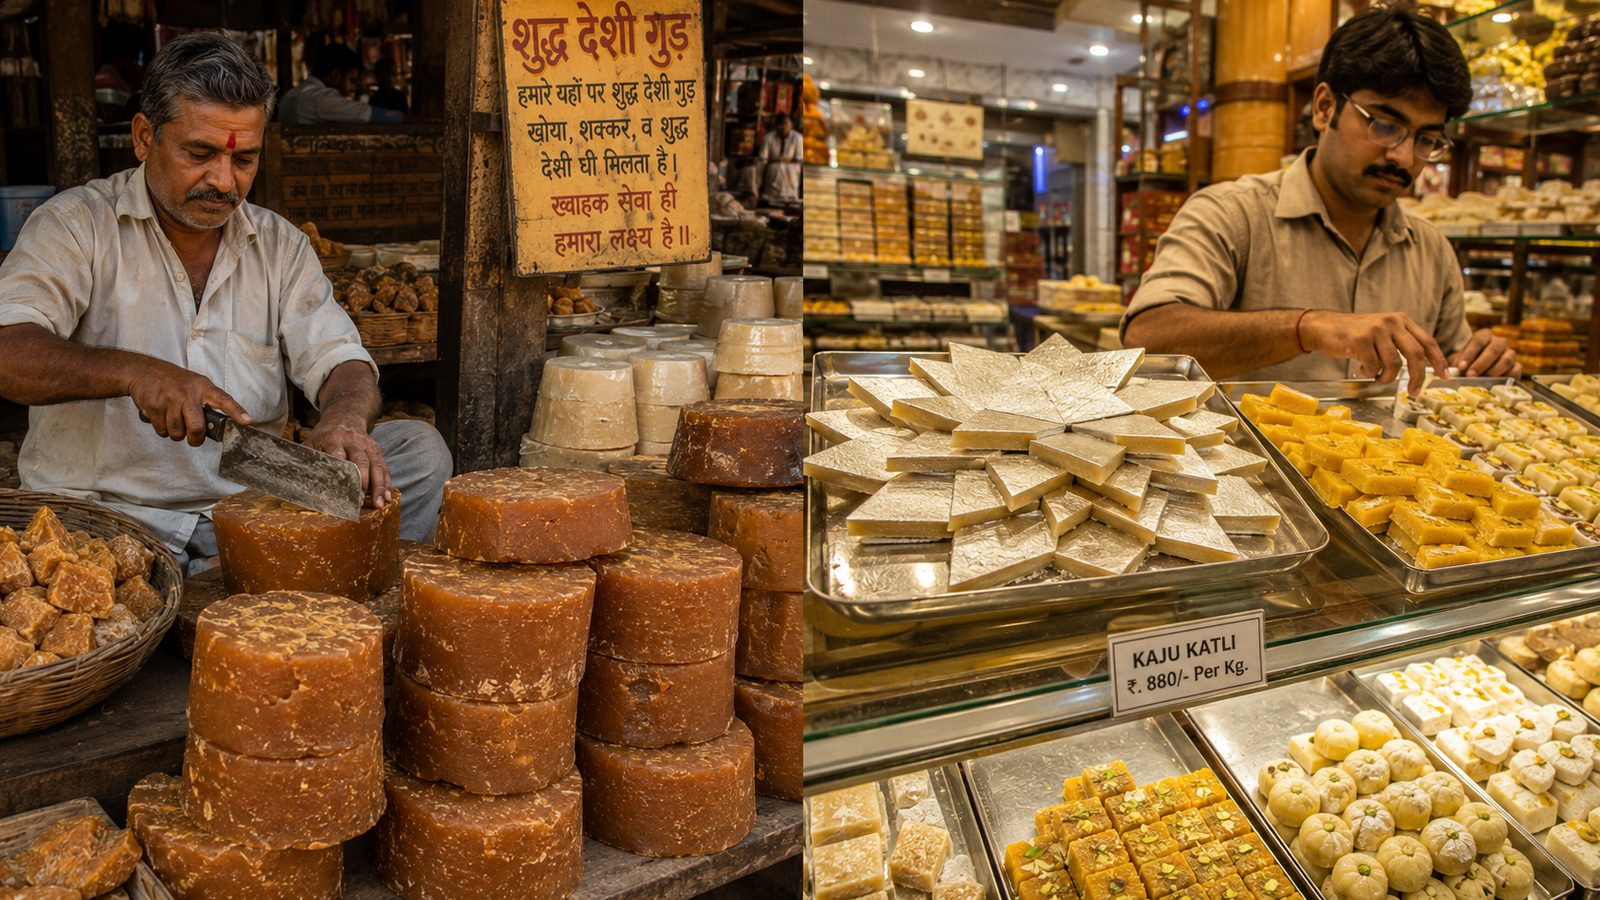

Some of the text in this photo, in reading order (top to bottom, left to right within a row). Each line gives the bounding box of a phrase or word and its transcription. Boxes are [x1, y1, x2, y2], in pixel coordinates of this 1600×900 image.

[512, 1, 692, 74] शुद्ध देशी गुड़
[517, 78, 552, 108] हमारे
[586, 83, 606, 103] पर
[612, 82, 638, 110] शुद्ध
[643, 73, 671, 102] देशी
[674, 80, 696, 107] गुड़
[580, 119, 635, 142] शक्कर,
[641, 118, 653, 137] व
[660, 117, 689, 146] शुद्ध
[578, 149, 598, 176] घी
[603, 147, 651, 176] मिलता
[617, 184, 652, 215] सेवा
[660, 182, 677, 212] ही
[554, 231, 602, 258] हमारा
[609, 226, 653, 252] लक्ष्य
[1133, 634, 1236, 669] KAJU KATLI
[1147, 669, 1189, 691] 880/-
[1194, 666, 1220, 681] Per
[1225, 660, 1248, 676] Kg.
